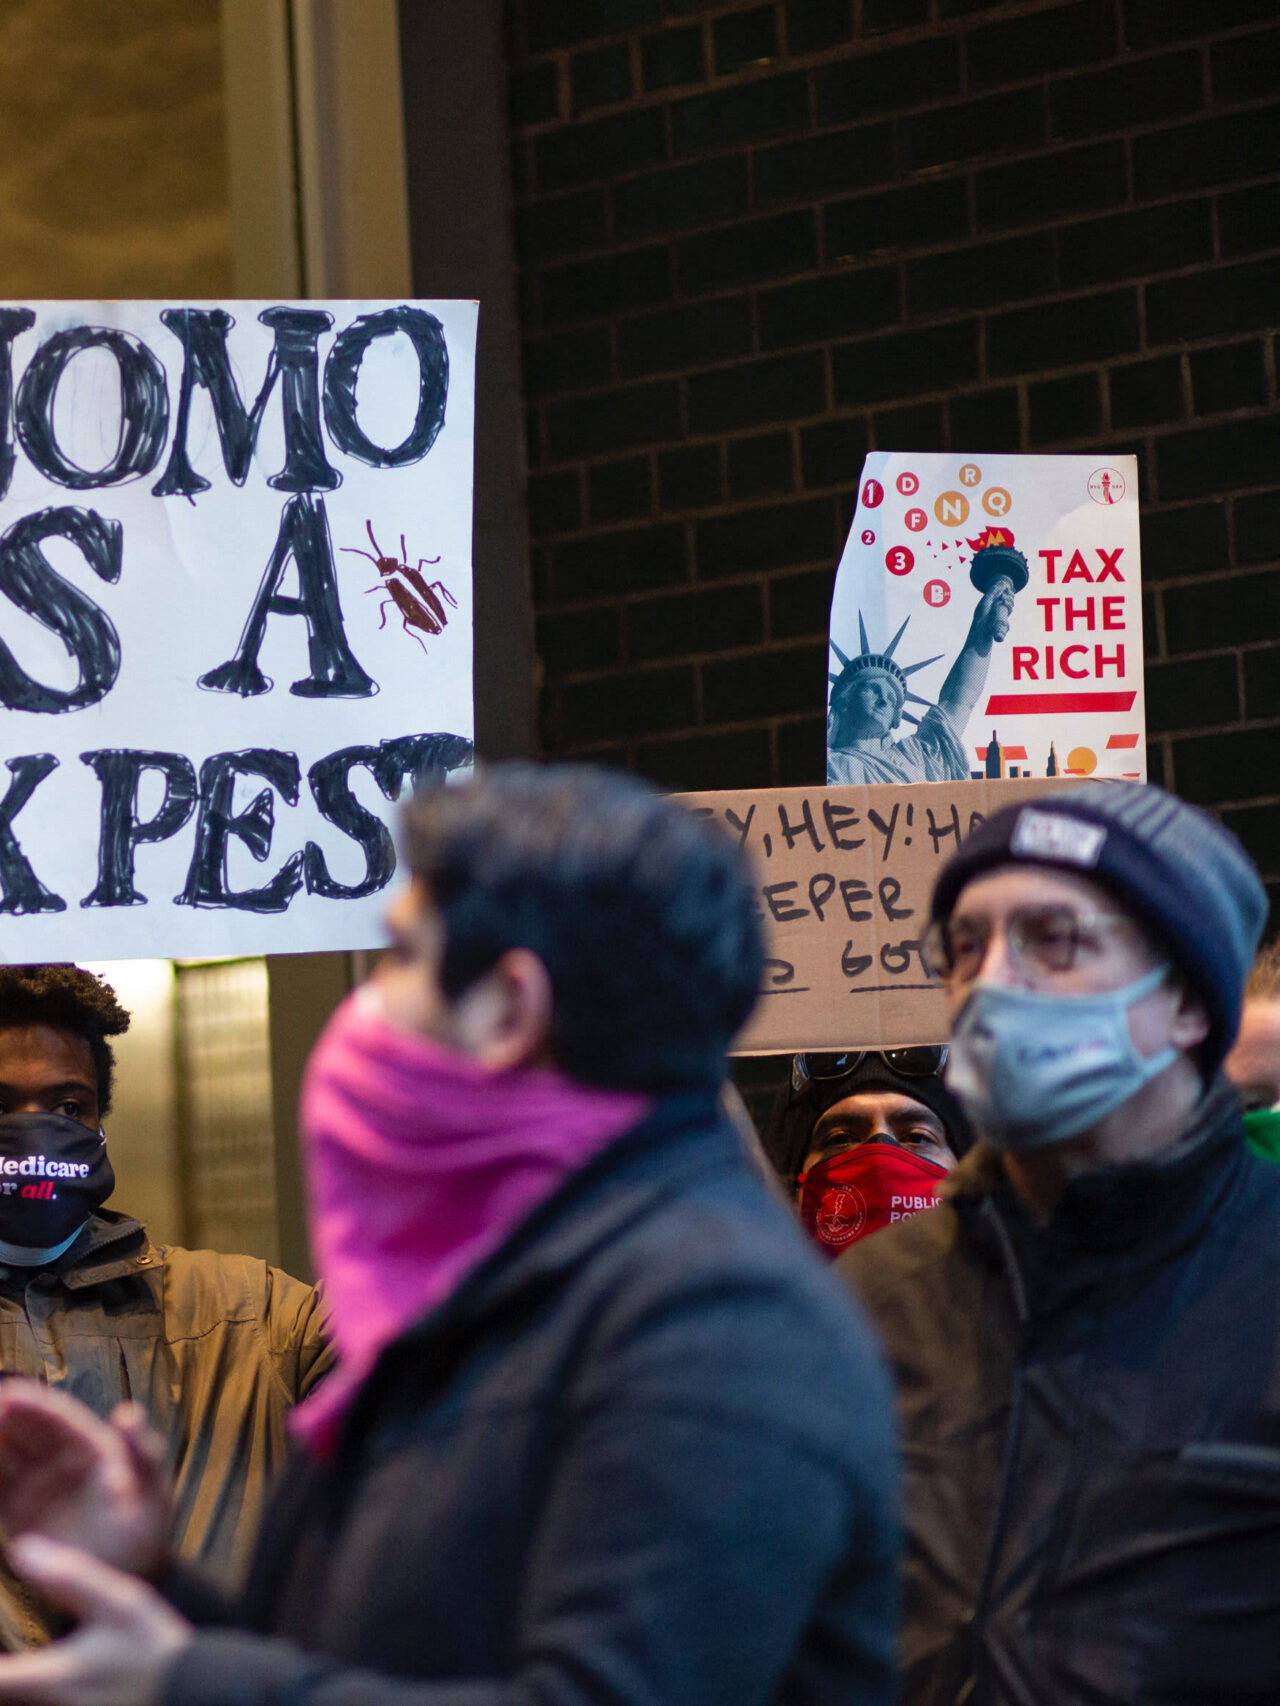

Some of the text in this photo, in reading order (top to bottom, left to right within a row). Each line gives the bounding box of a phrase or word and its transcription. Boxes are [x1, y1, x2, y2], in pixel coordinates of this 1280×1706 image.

[902, 477, 914, 492] D
[964, 468, 975, 484] R
[867, 483, 875, 504] 1
[988, 492, 1006, 515] Q
[911, 513, 921, 528] F
[942, 498, 961, 521] N
[865, 531, 872, 544] 2
[894, 552, 906, 571] 3
[1038, 548, 1125, 584] TAX
[197, 491, 381, 698] A
[1036, 596, 1126, 632] THE
[1012, 644, 1125, 681] RICH
[758, 873, 915, 922] EPER
[22, 1181, 57, 1200] all.
